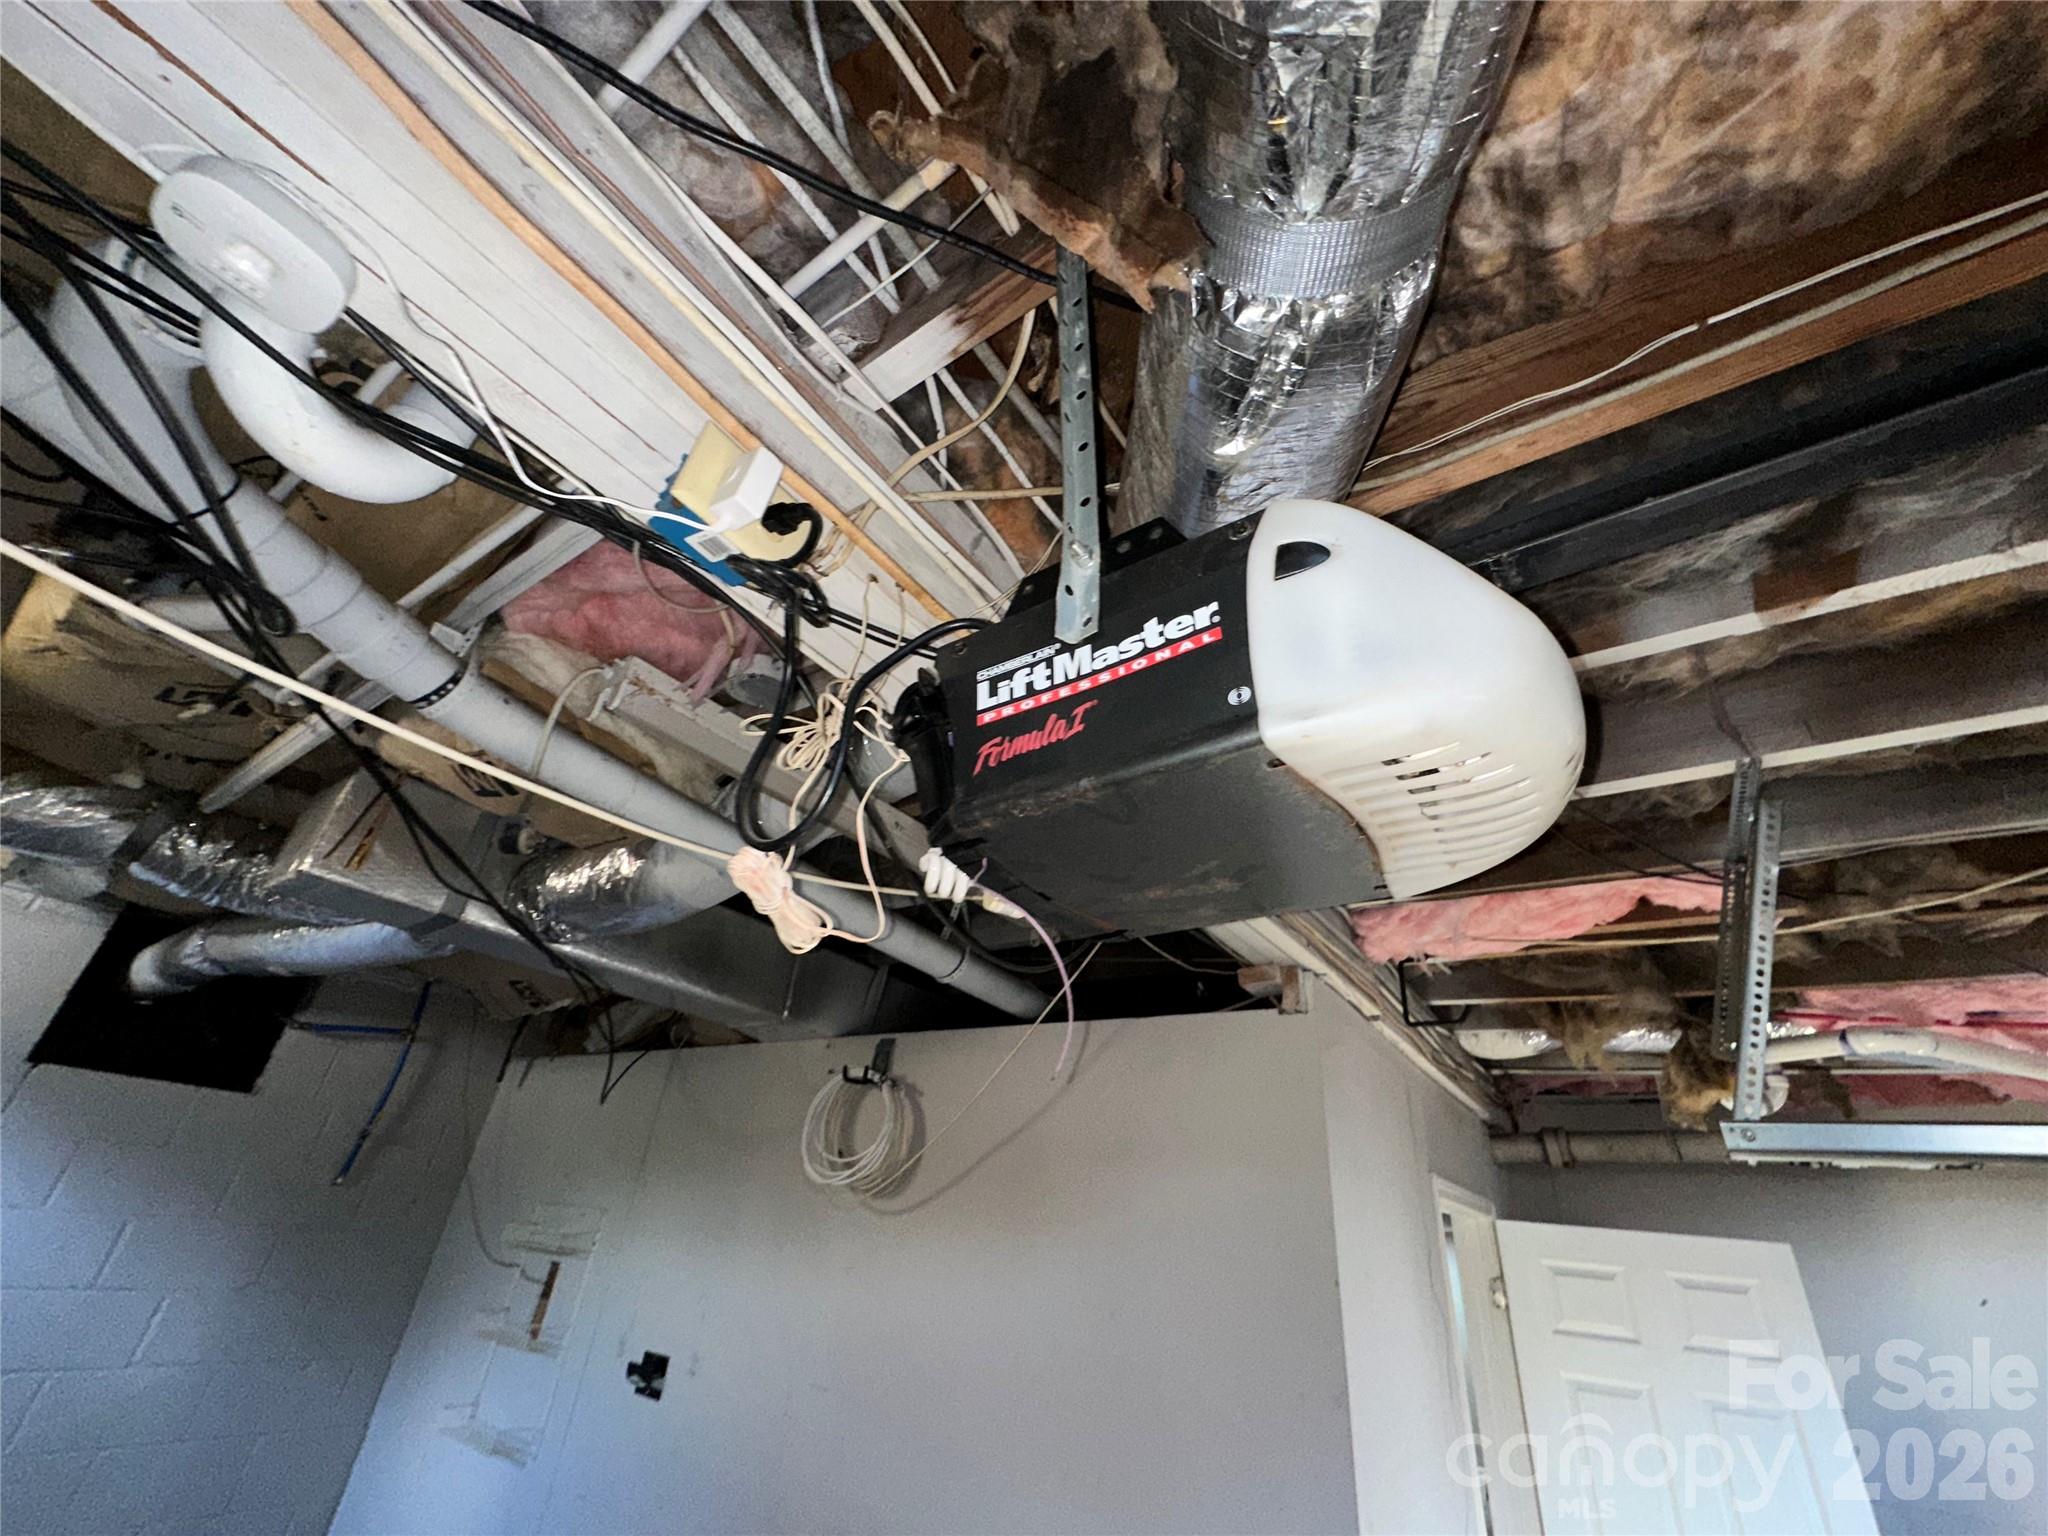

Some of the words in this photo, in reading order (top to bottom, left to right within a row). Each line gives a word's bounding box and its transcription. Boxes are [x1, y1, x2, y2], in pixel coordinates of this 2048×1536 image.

[977, 601, 1220, 710] LiftMaster
[983, 633, 1215, 723] PROFESSIONAL
[973, 713, 1066, 777] Formula
